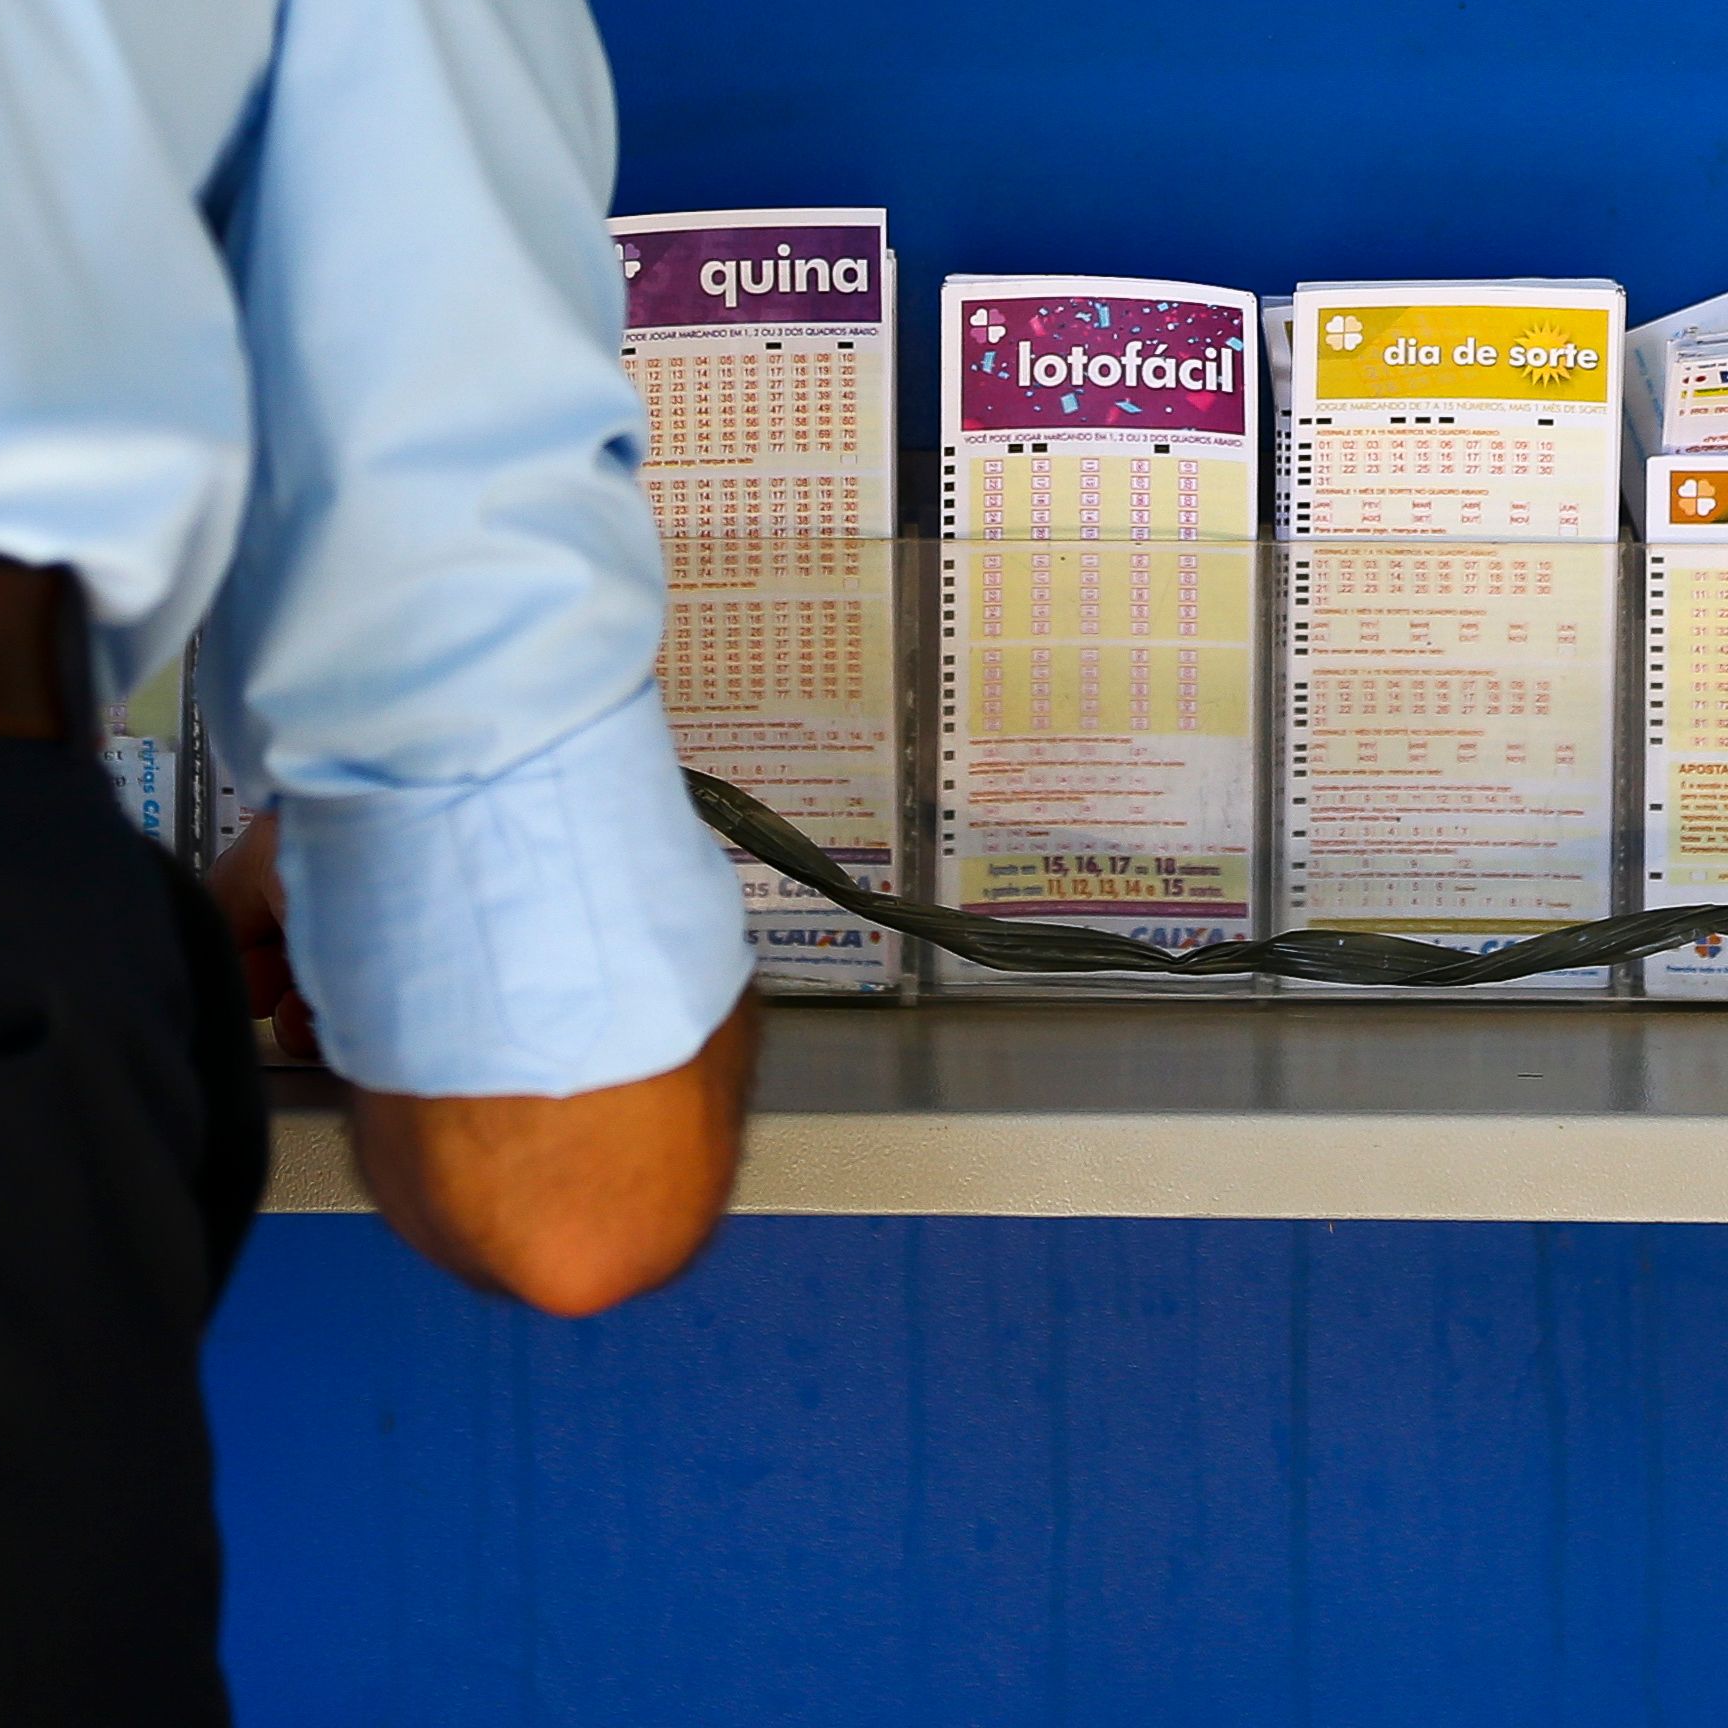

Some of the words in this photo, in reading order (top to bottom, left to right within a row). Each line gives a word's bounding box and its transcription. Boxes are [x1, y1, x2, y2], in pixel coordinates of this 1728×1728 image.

[700, 243, 868, 308] quina
[626, 332, 647, 342] PODE
[649, 331, 677, 341] JOGAR
[678, 330, 727, 339] MARCANDO
[761, 329, 775, 337] OU
[778, 328, 783, 336] 3
[785, 328, 803, 336] DOS
[806, 328, 847, 336] QUADROS
[1383, 337, 1441, 366] dia
[1452, 337, 1497, 366] de
[1509, 343, 1599, 369] sorte
[1018, 341, 1233, 392] lotofácil
[1350, 402, 1407, 411] MARCANDO
[1410, 402, 1422, 411] DE
[1564, 404, 1578, 414] DE
[1580, 405, 1607, 415] SORTE
[964, 433, 987, 444] VOCÊ
[989, 433, 1011, 442] PODE
[1013, 433, 1042, 441] JOGAR
[1044, 433, 1092, 441] MARCANDO
[1094, 433, 1107, 441] EM
[1127, 434, 1140, 442] OU
[1150, 434, 1168, 443] DOS
[1171, 436, 1211, 444] QUADROS
[1043, 857, 1070, 876] 15,
[1075, 857, 1103, 877] 16,
[1109, 857, 1131, 875] 17
[1155, 858, 1176, 875] 18
[1163, 879, 1183, 896] 15
[767, 930, 862, 948] CAIXA
[1130, 928, 1224, 949] CAIXA
